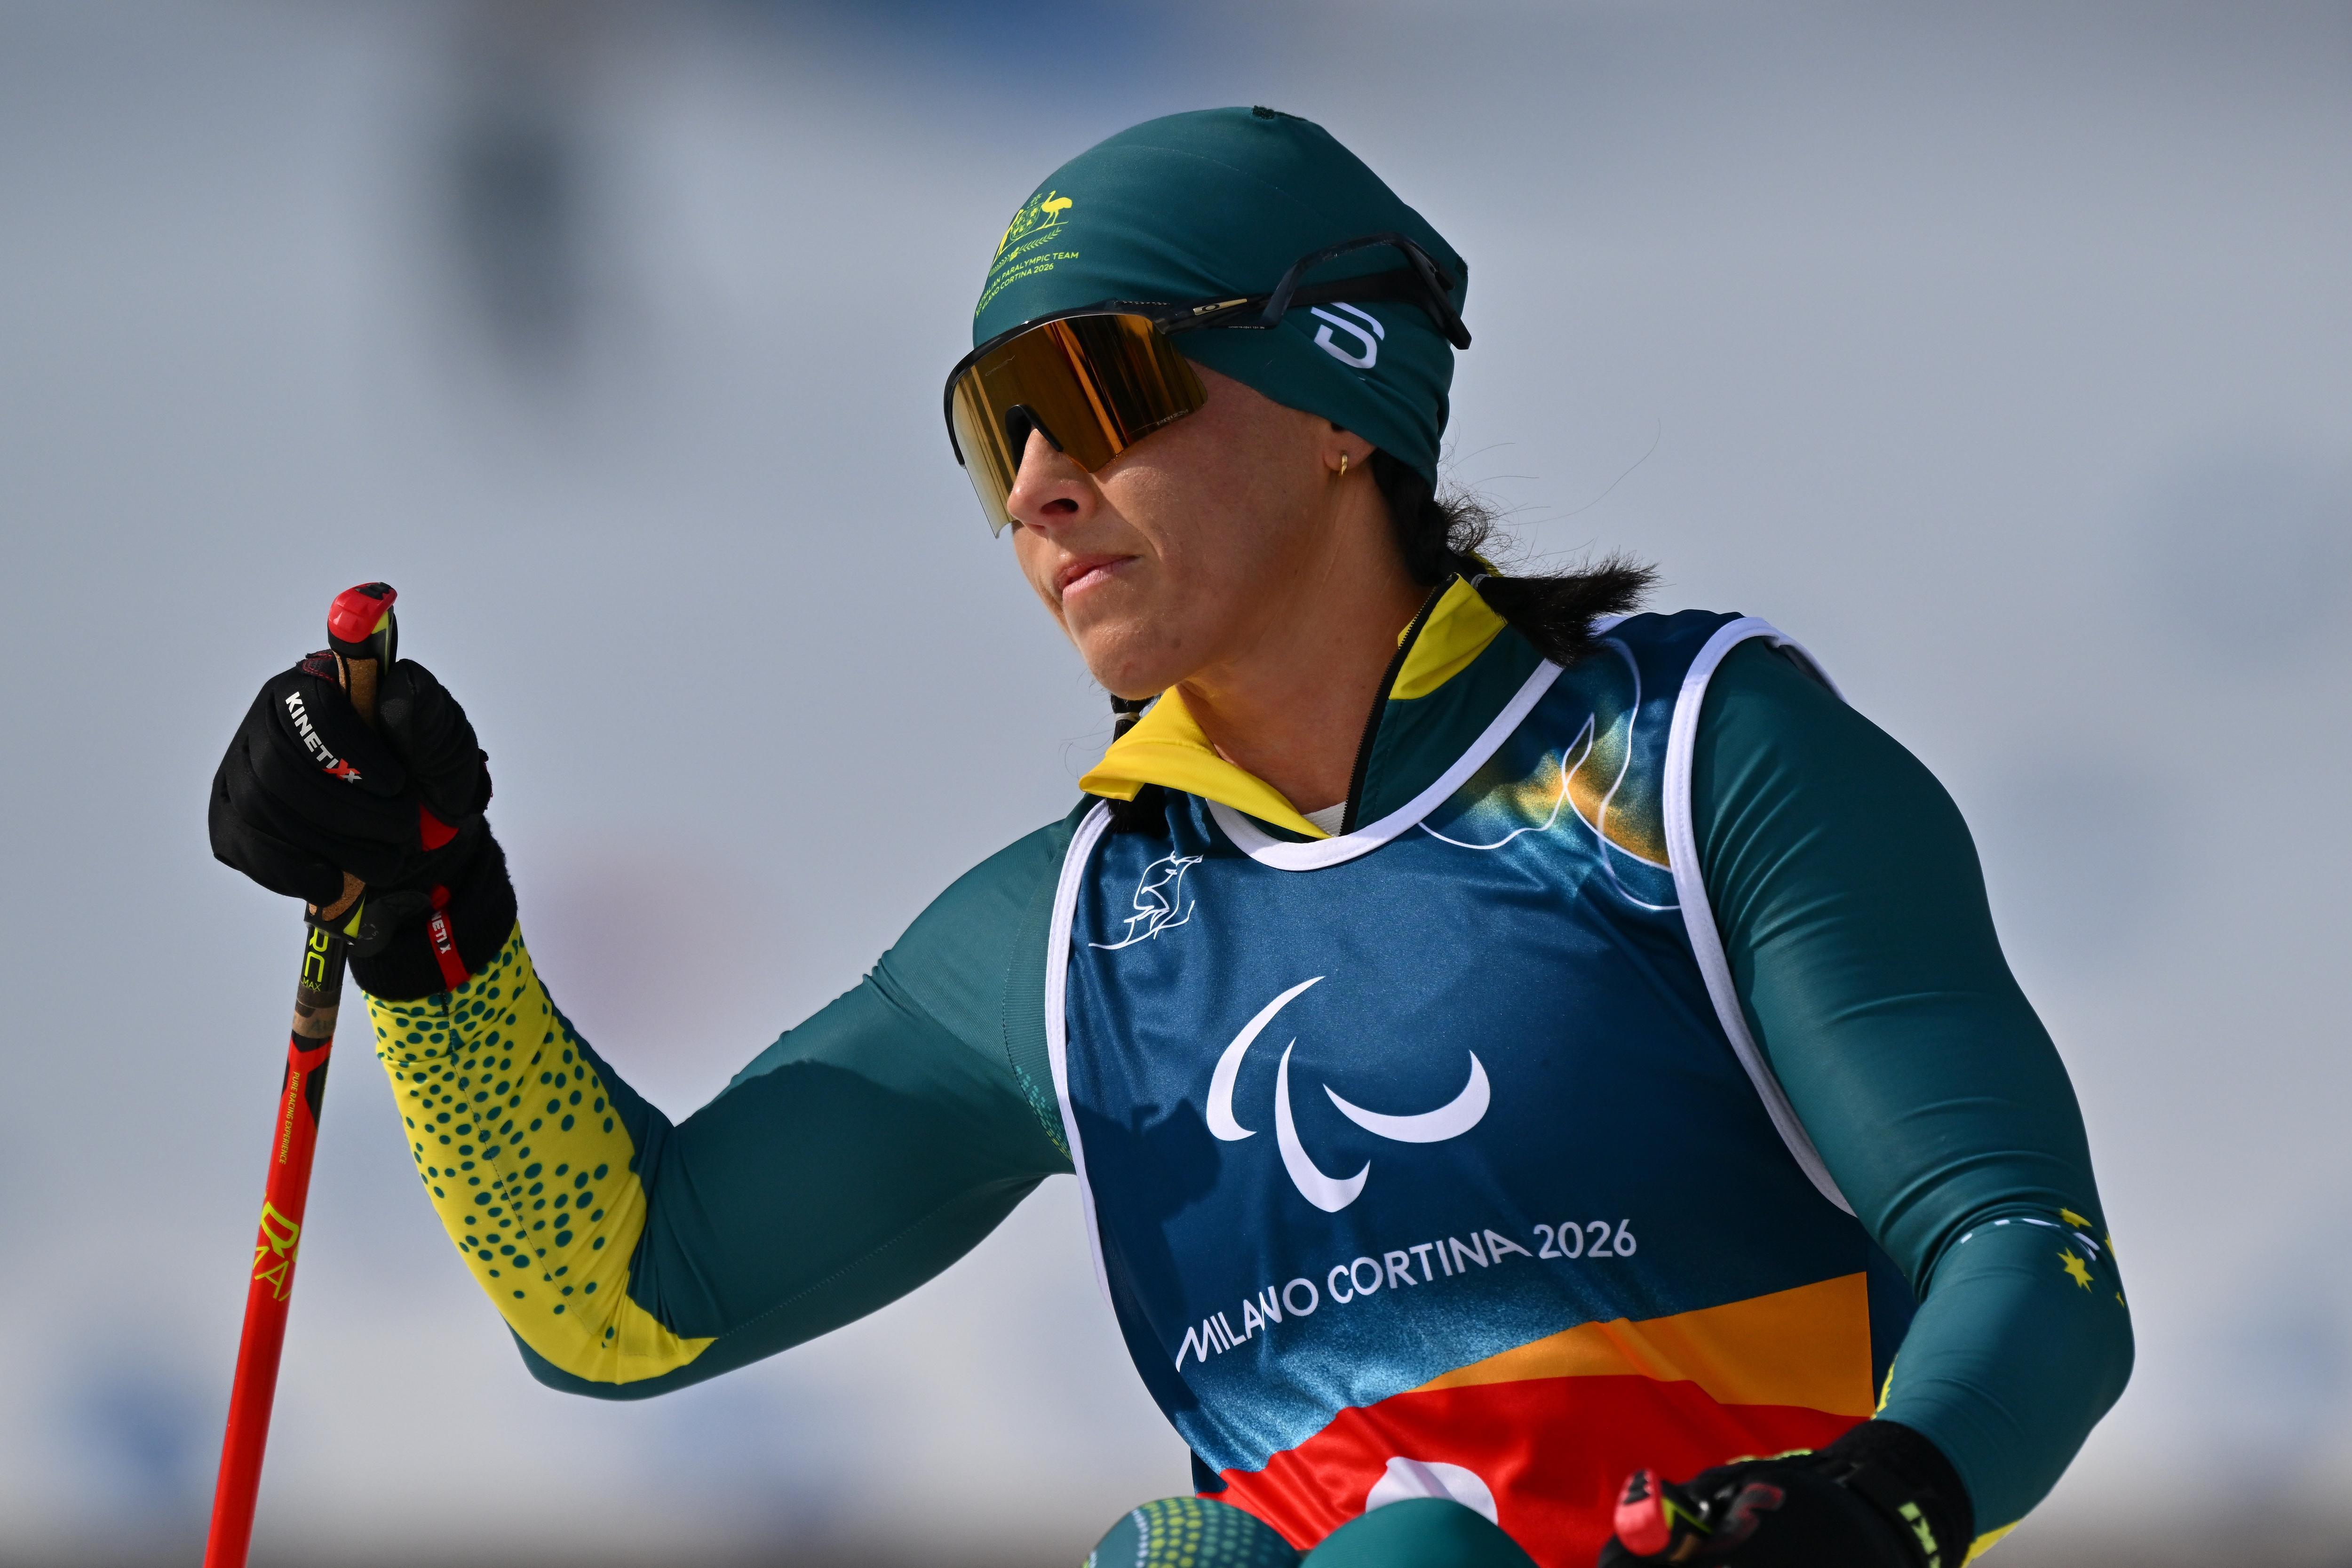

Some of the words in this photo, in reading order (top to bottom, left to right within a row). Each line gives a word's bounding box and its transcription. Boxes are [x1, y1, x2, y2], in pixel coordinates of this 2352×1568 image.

[976, 276, 1001, 319] AUSTRALIAN
[1001, 254, 1050, 280] PARALYMPIC
[981, 286, 1000, 313] MILANO
[1000, 268, 1032, 289] CORTINA
[1033, 263, 1054, 274] 2026
[303, 977, 322, 992] MAX
[291, 1071, 301, 1092] PURE
[286, 1092, 297, 1120] RACING
[279, 1121, 293, 1165] EXPERIENCE
[1175, 1277, 1319, 1372] MILANO
[1327, 1229, 1534, 1304] CORTINA
[1533, 1218, 1637, 1259] 2026
